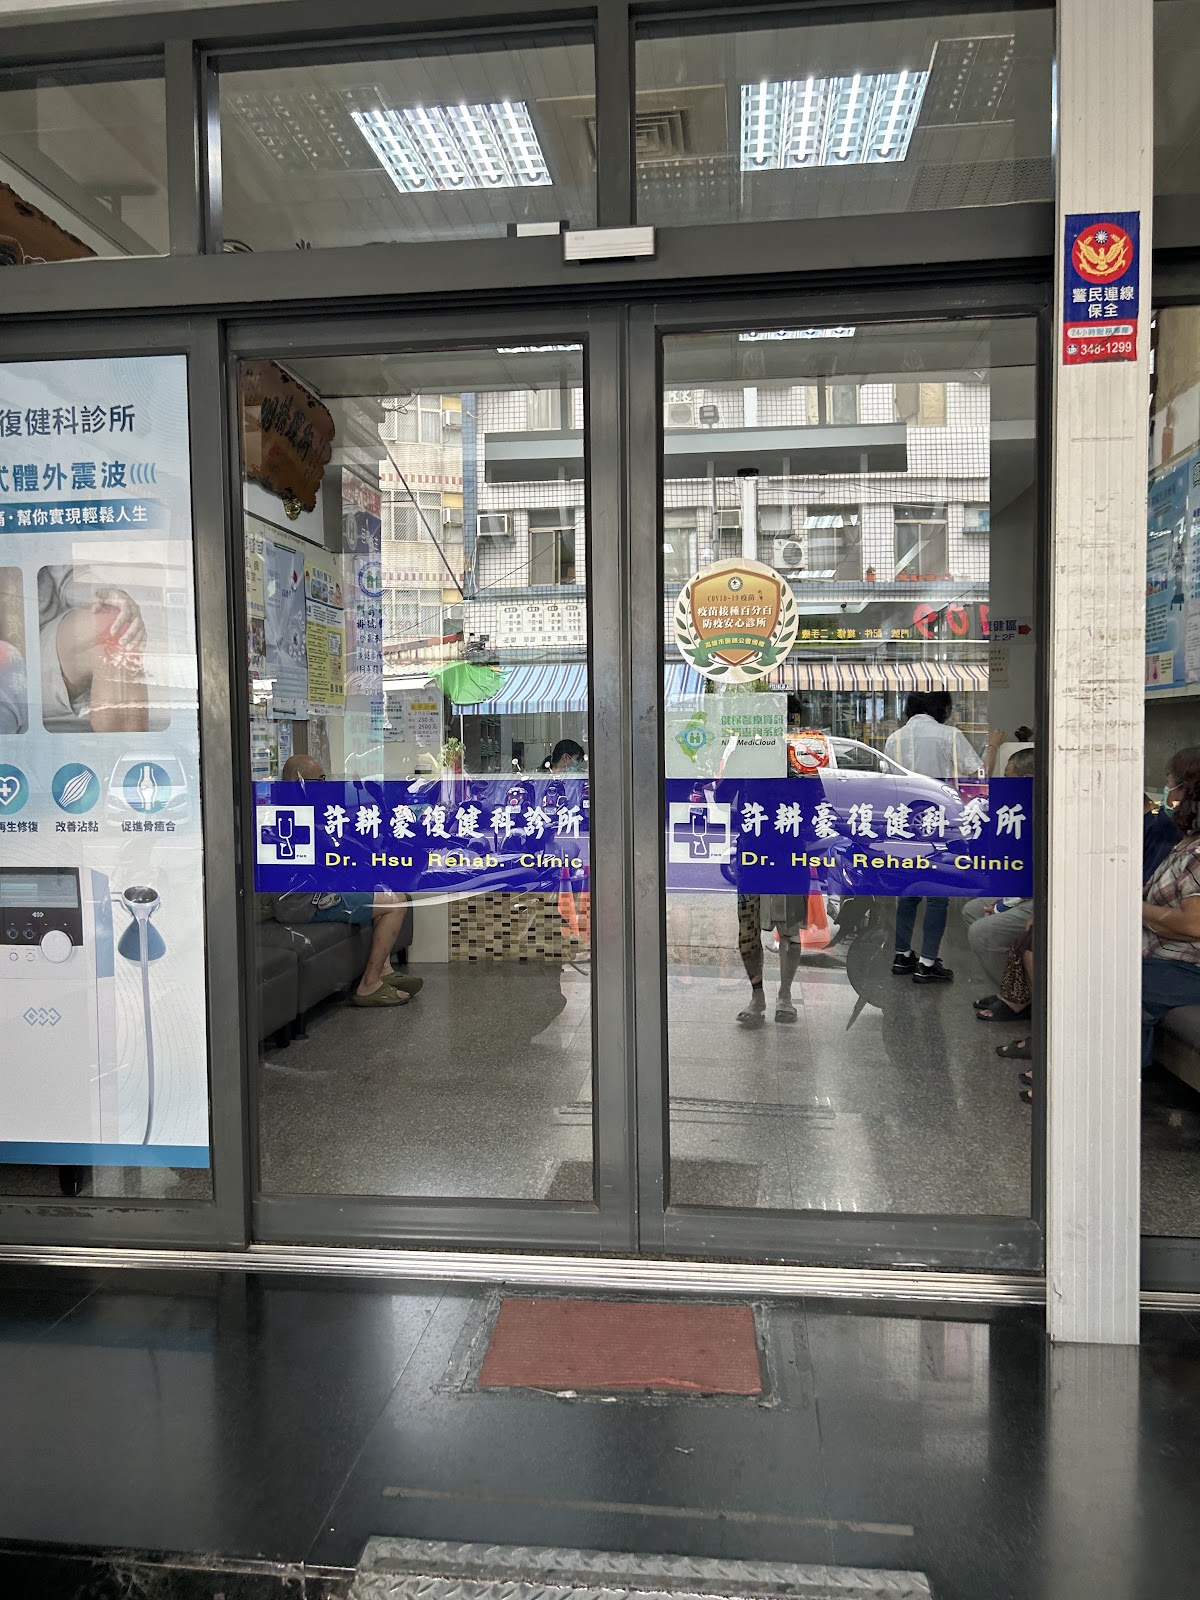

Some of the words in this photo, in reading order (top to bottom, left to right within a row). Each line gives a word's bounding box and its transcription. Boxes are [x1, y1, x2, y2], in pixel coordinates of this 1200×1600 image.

[1072, 286, 1134, 303] 警民連線
[1088, 303, 1118, 318] 保全
[0, 404, 136, 437] 復健科診所
[697, 605, 773, 617] 疫苗接種百分百
[702, 618, 767, 629] 防疫安心診所
[721, 715, 784, 725] 健保醫療資訊
[55, 821, 99, 832] 改善沾黏
[121, 821, 176, 832] 促進骨癒合
[323, 804, 584, 840] 許耕豪復健科診所
[740, 802, 1026, 840] 許耕豪復健科診所
[325, 852, 357, 866] Dr.
[372, 853, 413, 867] Hsu
[428, 853, 505, 868] Rehab.
[520, 853, 583, 869] Clinic
[741, 851, 775, 866] Dr.
[791, 852, 836, 868] Hsu
[853, 853, 938, 870] Rehab.
[954, 855, 1025, 871] Clinic
